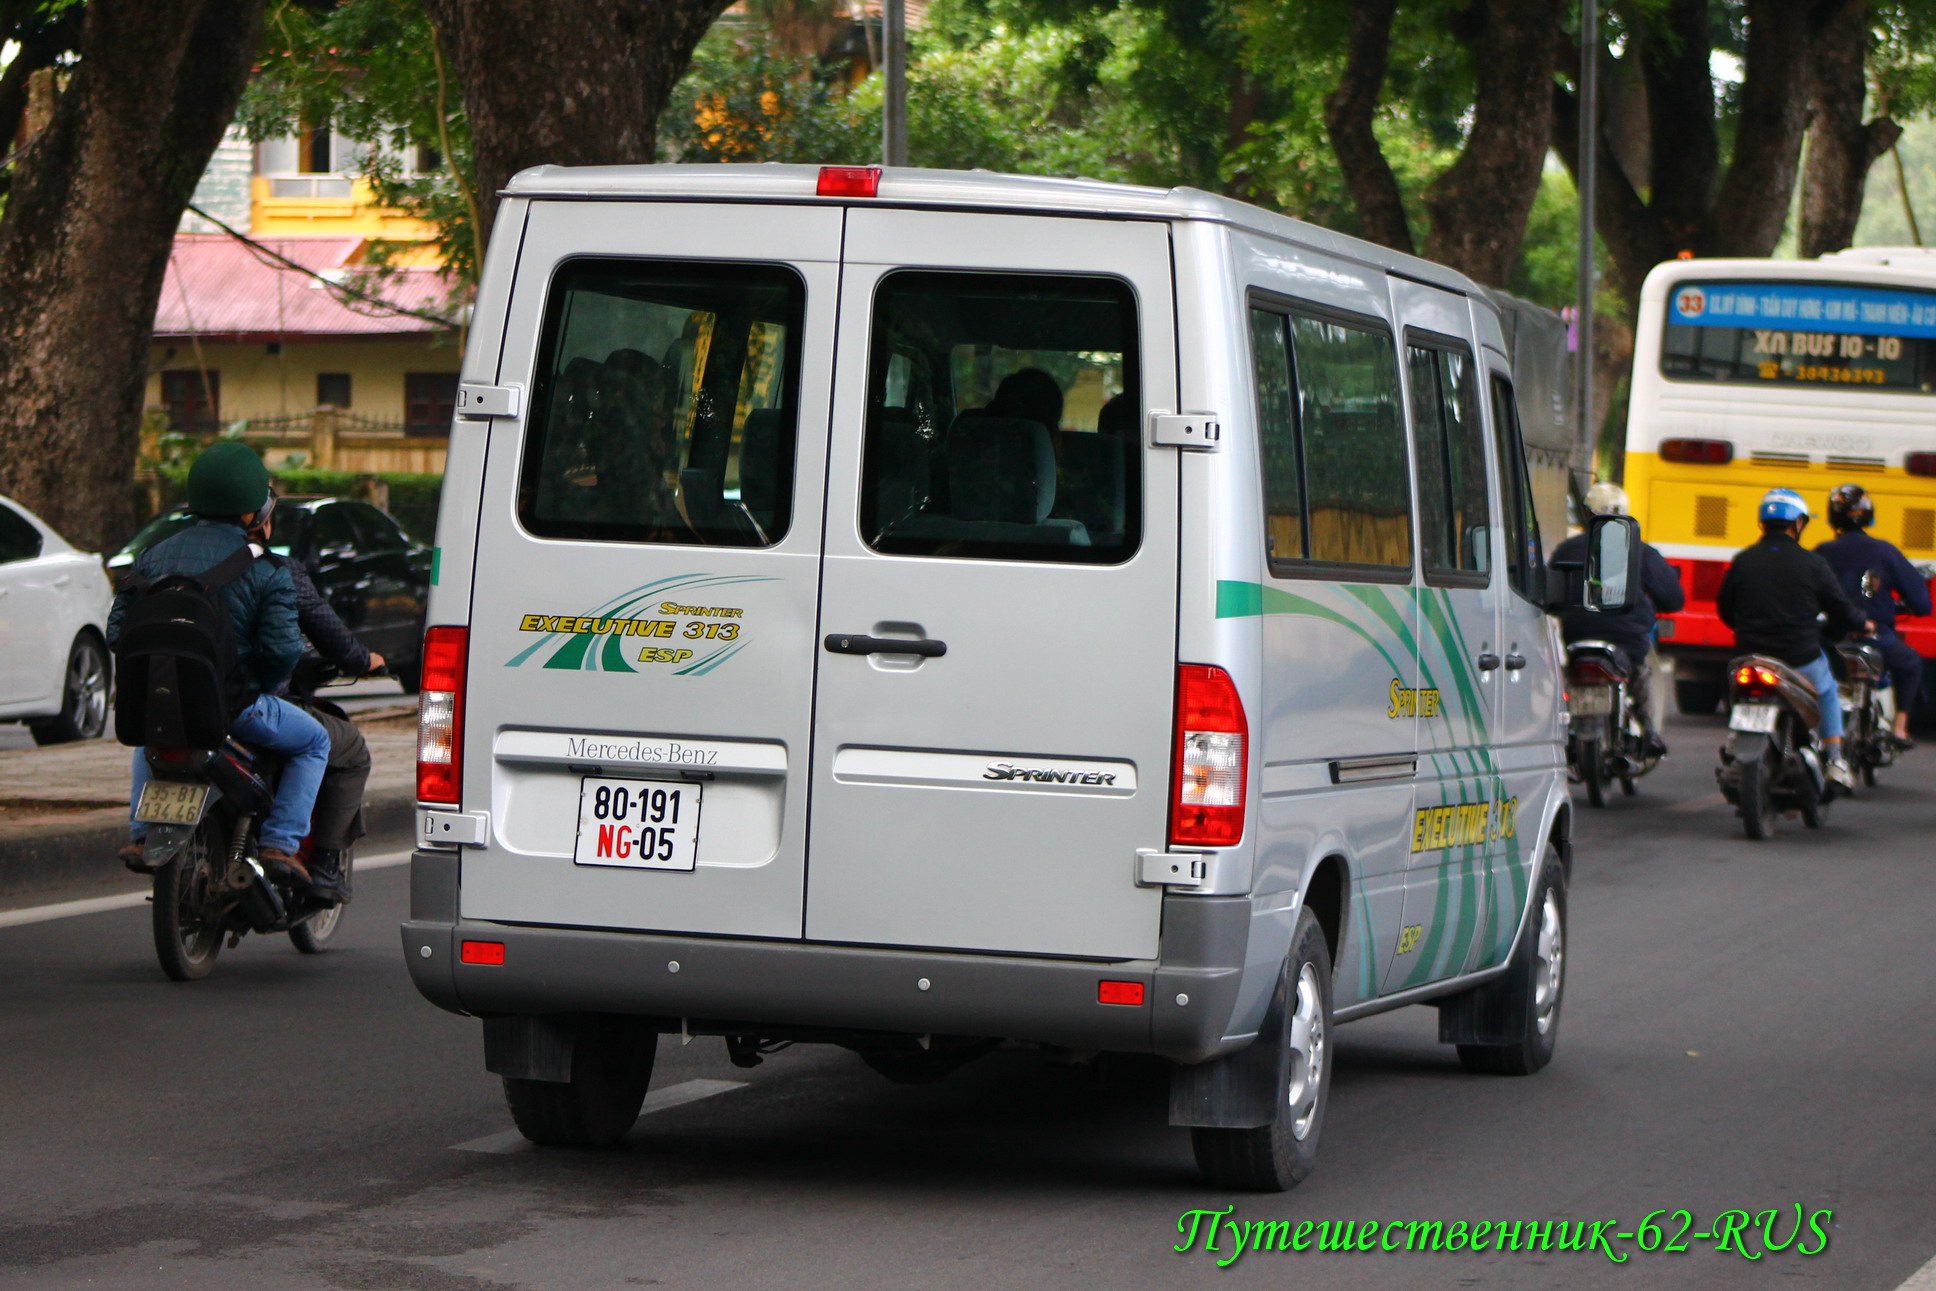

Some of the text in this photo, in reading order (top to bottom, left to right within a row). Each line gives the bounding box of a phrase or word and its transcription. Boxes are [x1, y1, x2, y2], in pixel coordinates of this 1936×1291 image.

[1678, 295, 1703, 313] 33
[1792, 332, 1836, 357] BUS
[519, 614, 740, 641] EXECUTIVE 313
[637, 647, 693, 663] ESP
[566, 737, 718, 765] Mercedes-Benz
[150, 783, 196, 803] 35-B1
[594, 785, 681, 824] 80-191
[143, 802, 197, 822] 134.46
[1411, 801, 1490, 854] EXECUTIVE
[597, 824, 675, 861] NG-05
[1396, 924, 1422, 955] ESP
